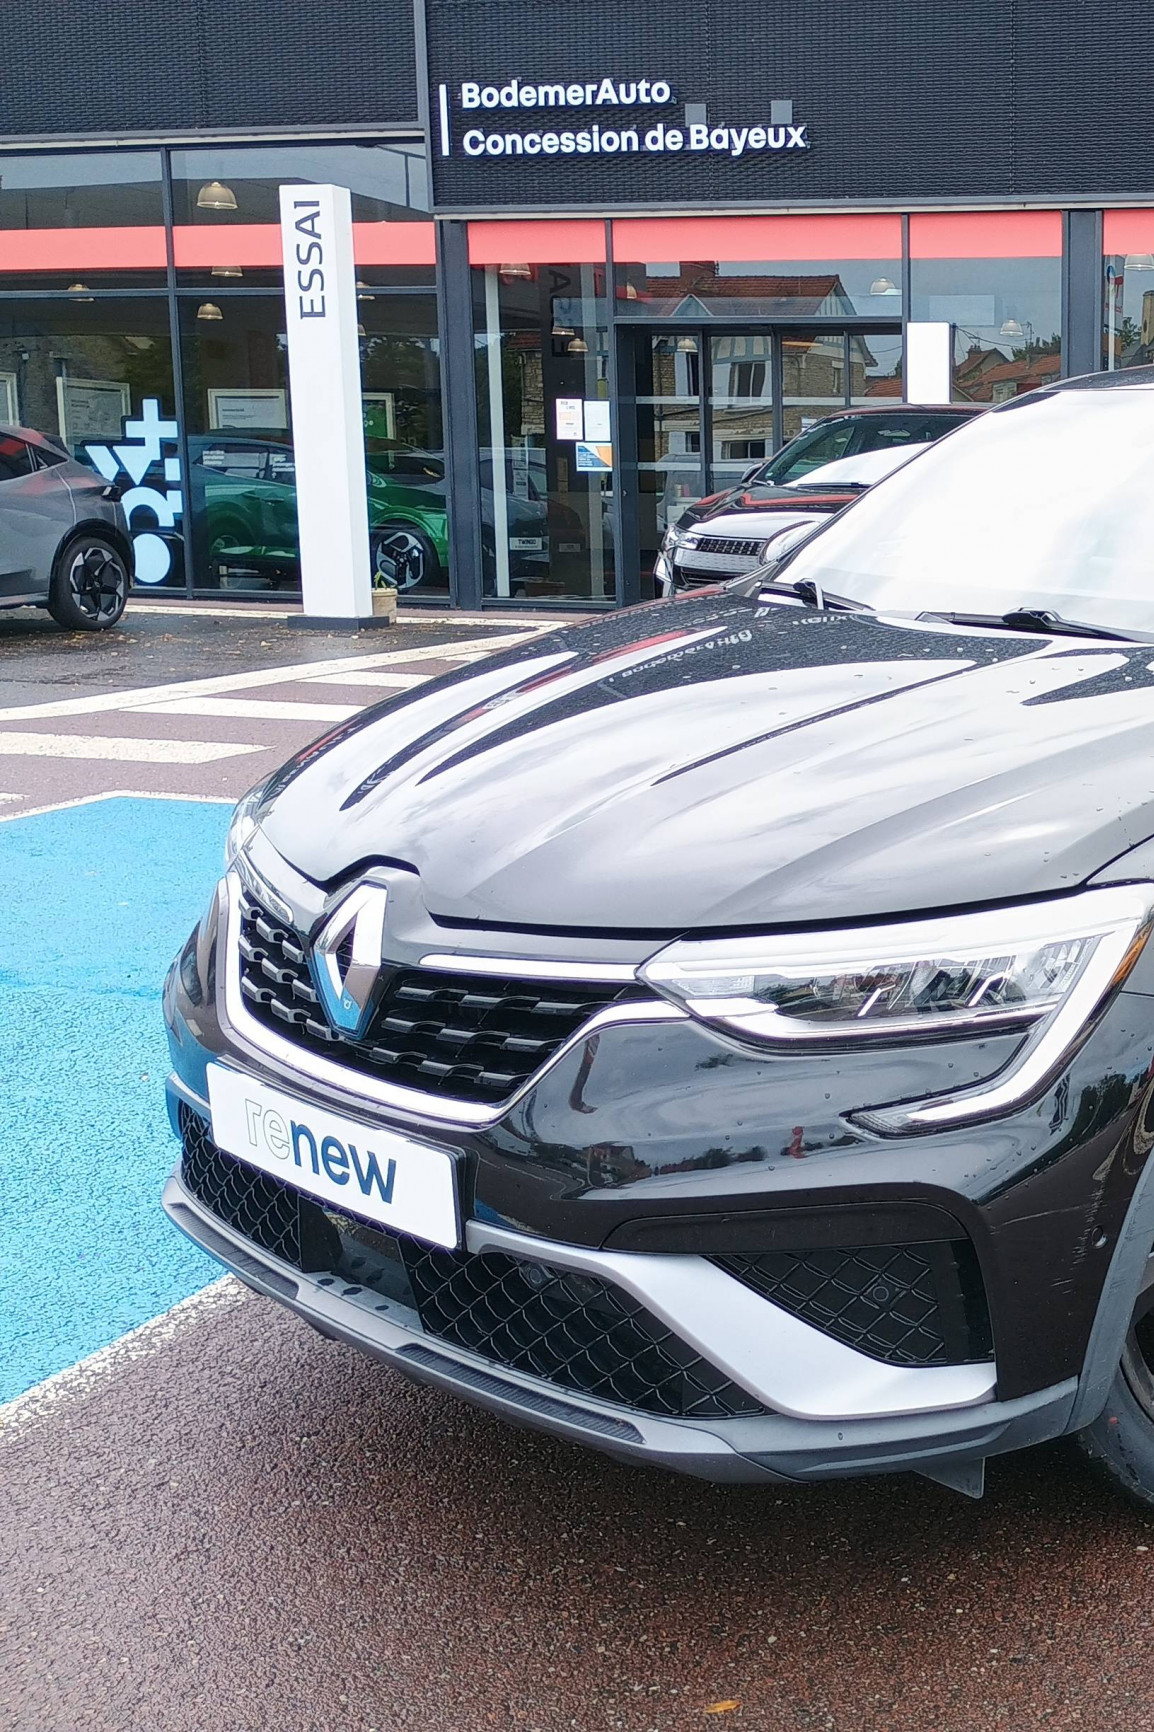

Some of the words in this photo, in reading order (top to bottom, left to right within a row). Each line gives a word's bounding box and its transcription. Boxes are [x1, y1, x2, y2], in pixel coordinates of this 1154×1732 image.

[461, 78, 671, 109] BodemerAuto
[463, 125, 639, 156] Concession
[644, 124, 684, 151] de
[689, 123, 807, 156] Bayeux
[293, 200, 326, 320] ESSAI
[244, 1098, 397, 1205] renew
